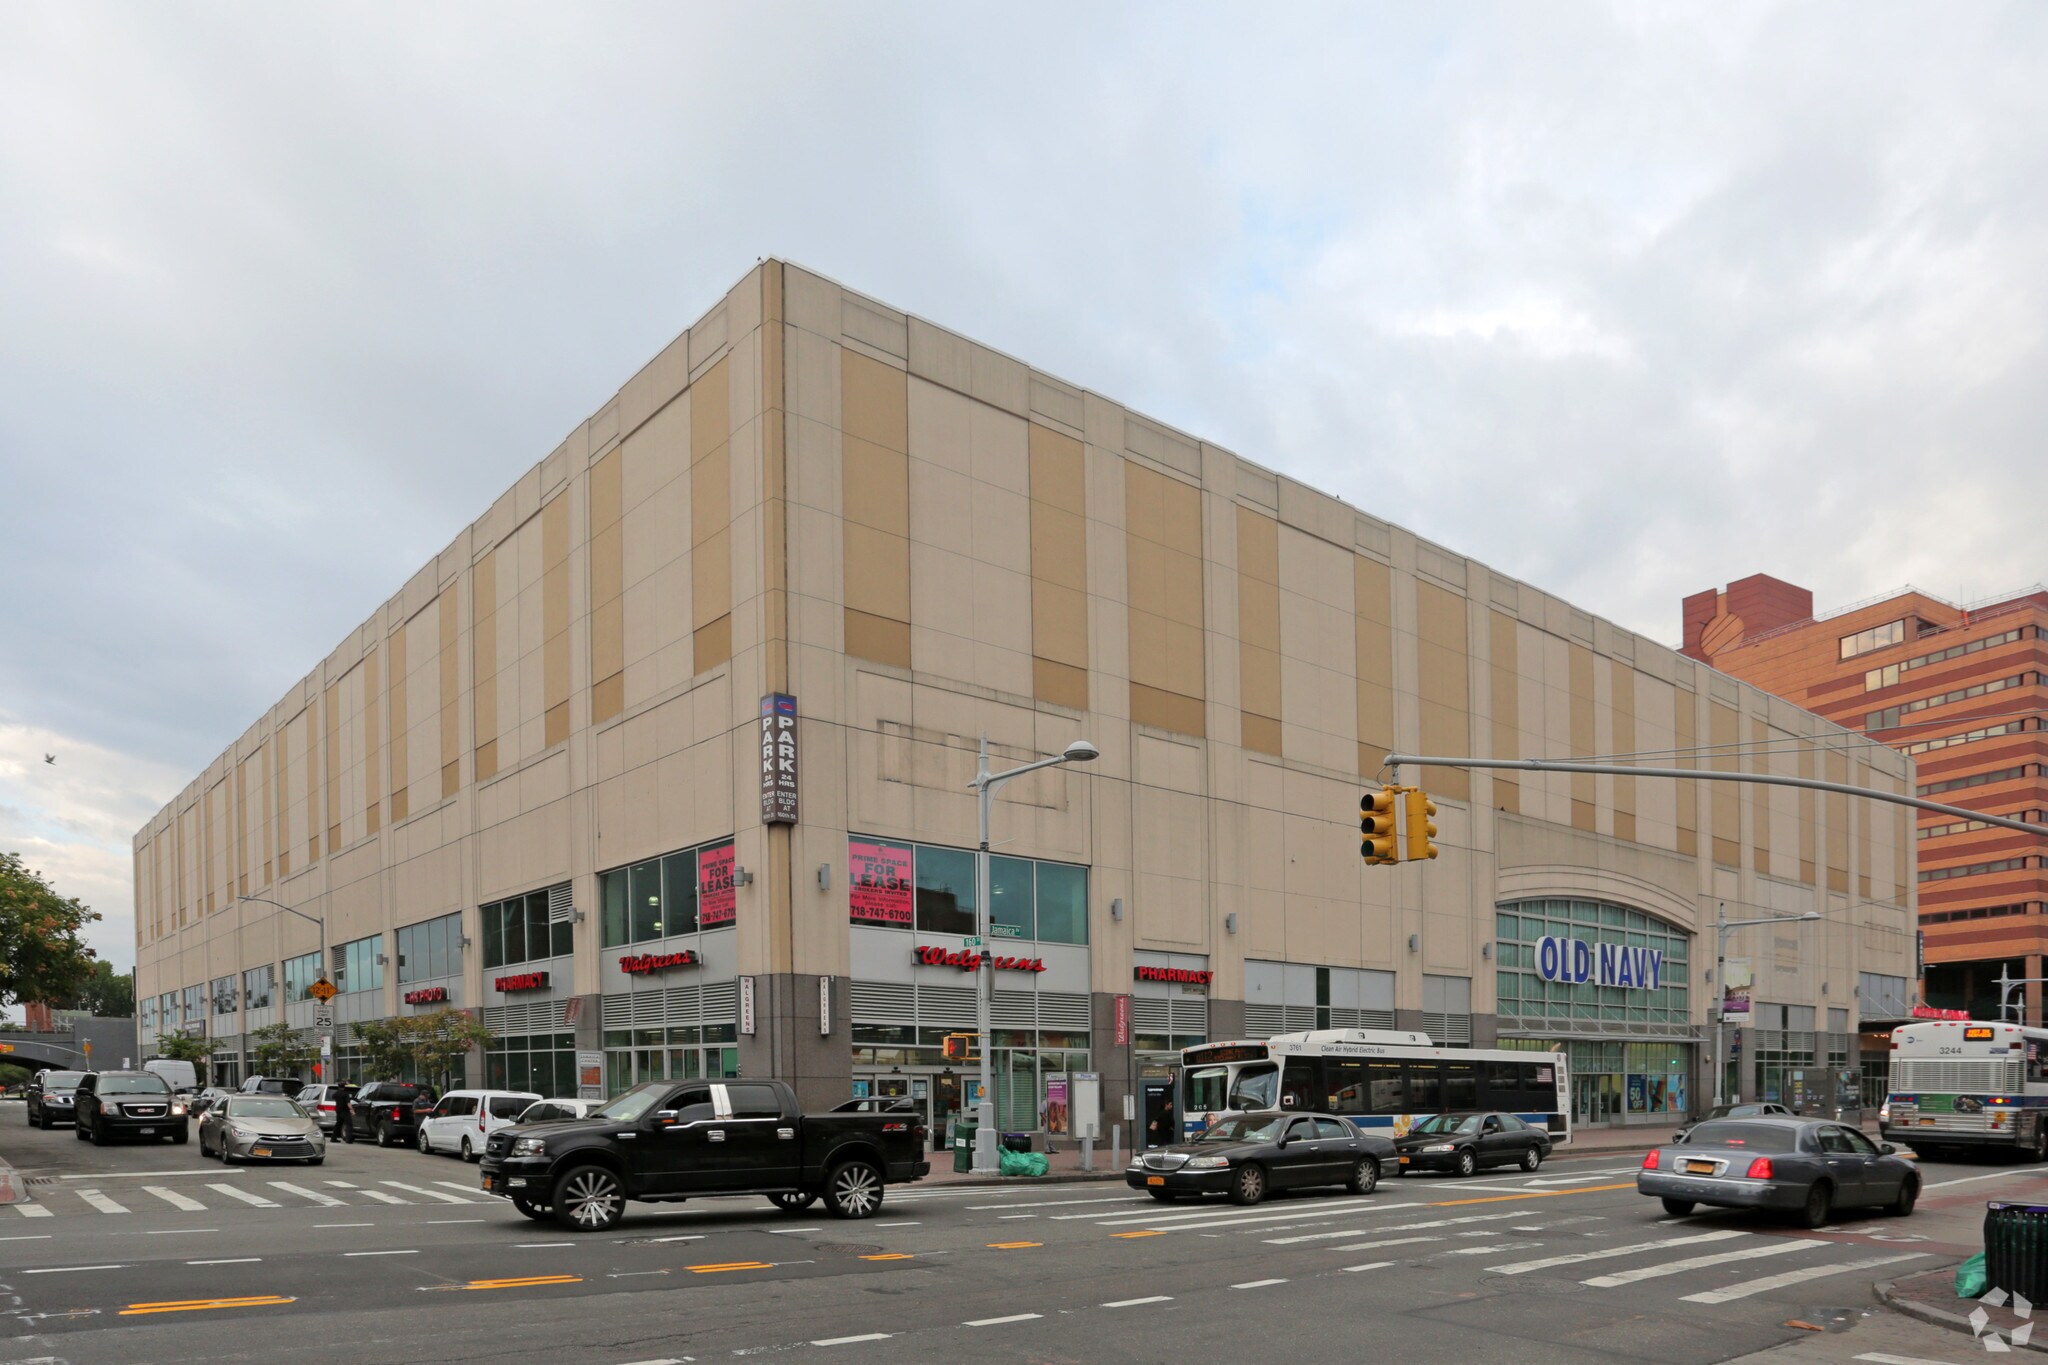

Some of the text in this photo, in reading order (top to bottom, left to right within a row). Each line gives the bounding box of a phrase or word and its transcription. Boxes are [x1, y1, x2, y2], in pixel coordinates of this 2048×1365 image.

[762, 716, 774, 773] PARK
[777, 715, 795, 773] PARK
[778, 780, 795, 788] HRS
[776, 790, 797, 799] ENTER
[778, 797, 796, 806] BLDG
[853, 854, 908, 867] PRIME SPACE
[709, 865, 728, 880] FOR
[865, 863, 895, 876] FOR
[850, 873, 910, 892] LEASE
[854, 886, 882, 894] BROKERS
[850, 905, 911, 921] 718-747-6700
[991, 926, 1015, 936] Jamaica
[966, 938, 976, 947] 160
[619, 949, 691, 975] Walgreens
[918, 945, 1047, 972] Walgeens
[1535, 935, 1663, 991] OLD NAVY
[495, 971, 543, 992] PHARMACY
[1139, 965, 1214, 985] PHARMACY
[419, 987, 442, 1002] PHOTO
[743, 978, 751, 1033] WALGREENS
[316, 1017, 331, 1026] 25
[1939, 1047, 1962, 1055] 3244
[1630, 1087, 1640, 1100] 50
